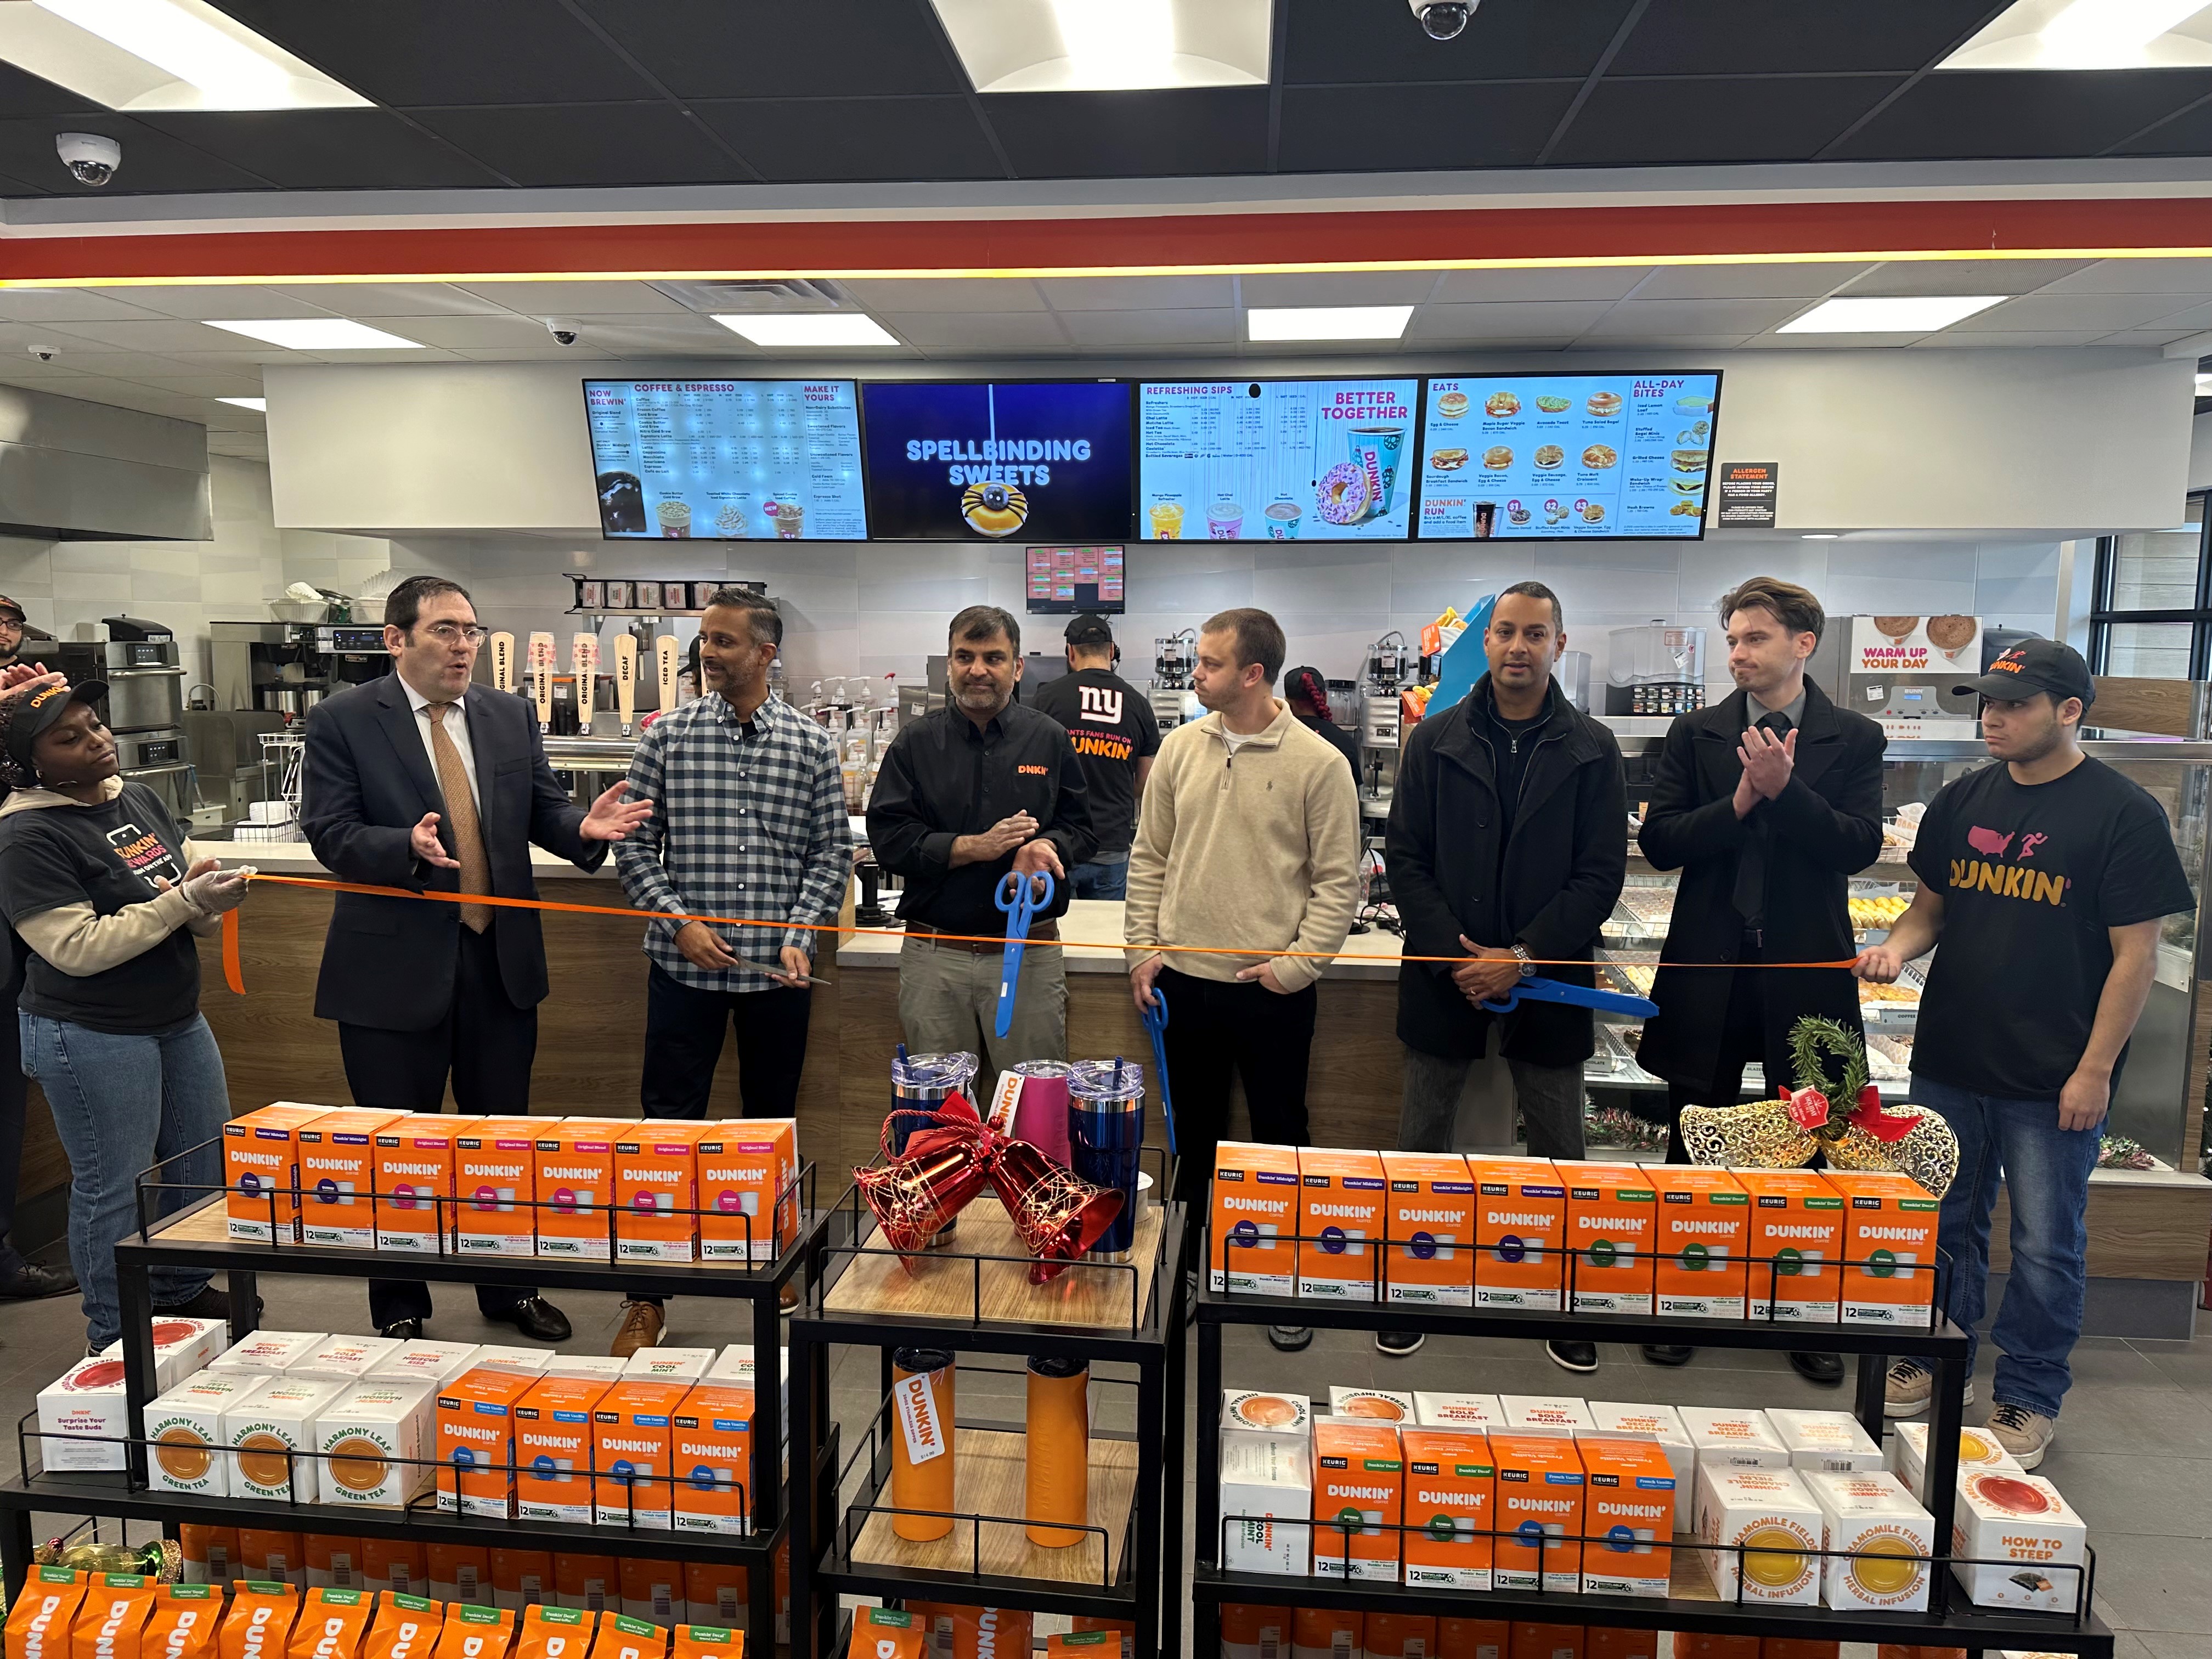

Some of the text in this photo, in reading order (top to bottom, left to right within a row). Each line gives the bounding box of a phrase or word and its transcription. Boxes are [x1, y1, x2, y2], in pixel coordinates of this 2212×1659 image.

[1147, 386, 1208, 394] REFRESHING
[1433, 383, 1459, 391] EATS
[1634, 380, 1684, 388] ALL-DAY
[1336, 392, 1396, 404] BETTER
[1633, 389, 1664, 397] BITES
[1322, 407, 1407, 420] TOGETHER
[906, 440, 1091, 460] SPELLBINDING
[949, 465, 1049, 486] SWEETS
[1364, 451, 1383, 502] DUNKIN'
[1425, 499, 1466, 507] DUNKIN'
[1509, 501, 1587, 510] $1 $2 $3
[1864, 647, 1927, 657] WARM UP
[1862, 658, 1928, 668] YOUR DAY
[1106, 733, 1120, 741] RUN
[1071, 736, 1133, 760] UNKIN'
[151, 858, 164, 867] THE
[1950, 859, 2072, 905] DUNKIN'
[232, 1151, 283, 1166] DUNKIN'
[383, 1163, 441, 1175] DUNKIN'
[544, 1167, 602, 1180] DUNKIN'
[707, 1169, 766, 1181] DUNKIN'
[1224, 1197, 1288, 1212] DUNKIN'
[1488, 1212, 1554, 1226] DUNKIN'
[1672, 1221, 1739, 1233] DUNKIN'
[1859, 1226, 1928, 1240] DUNKIN'
[306, 1230, 314, 1239] 12
[1391, 1289, 1402, 1299] 12
[1846, 1308, 1857, 1318] 12
[909, 1379, 935, 1446] DUNKIN'
[150, 1417, 214, 1443] HARMONY LEAF
[444, 1424, 500, 1441] DUNKIN'
[323, 1427, 392, 1452] HARMONY LEAF
[603, 1438, 661, 1453] DUNKIN'
[682, 1443, 741, 1458] DUNKIN'
[162, 1475, 210, 1490] GREEN TEA
[335, 1487, 386, 1500] GREEN TEA
[1328, 1485, 1393, 1499] DUNKIN'
[1508, 1498, 1575, 1511] DUNKIN'
[1843, 1524, 1930, 1561] CHAMOMILE FIELDS
[2002, 1536, 2062, 1550] HOW TO
[2009, 1548, 2053, 1560] STEEP
[1409, 1571, 1420, 1581] 12
[1843, 1575, 1926, 1605] HERBAL INFUSION
